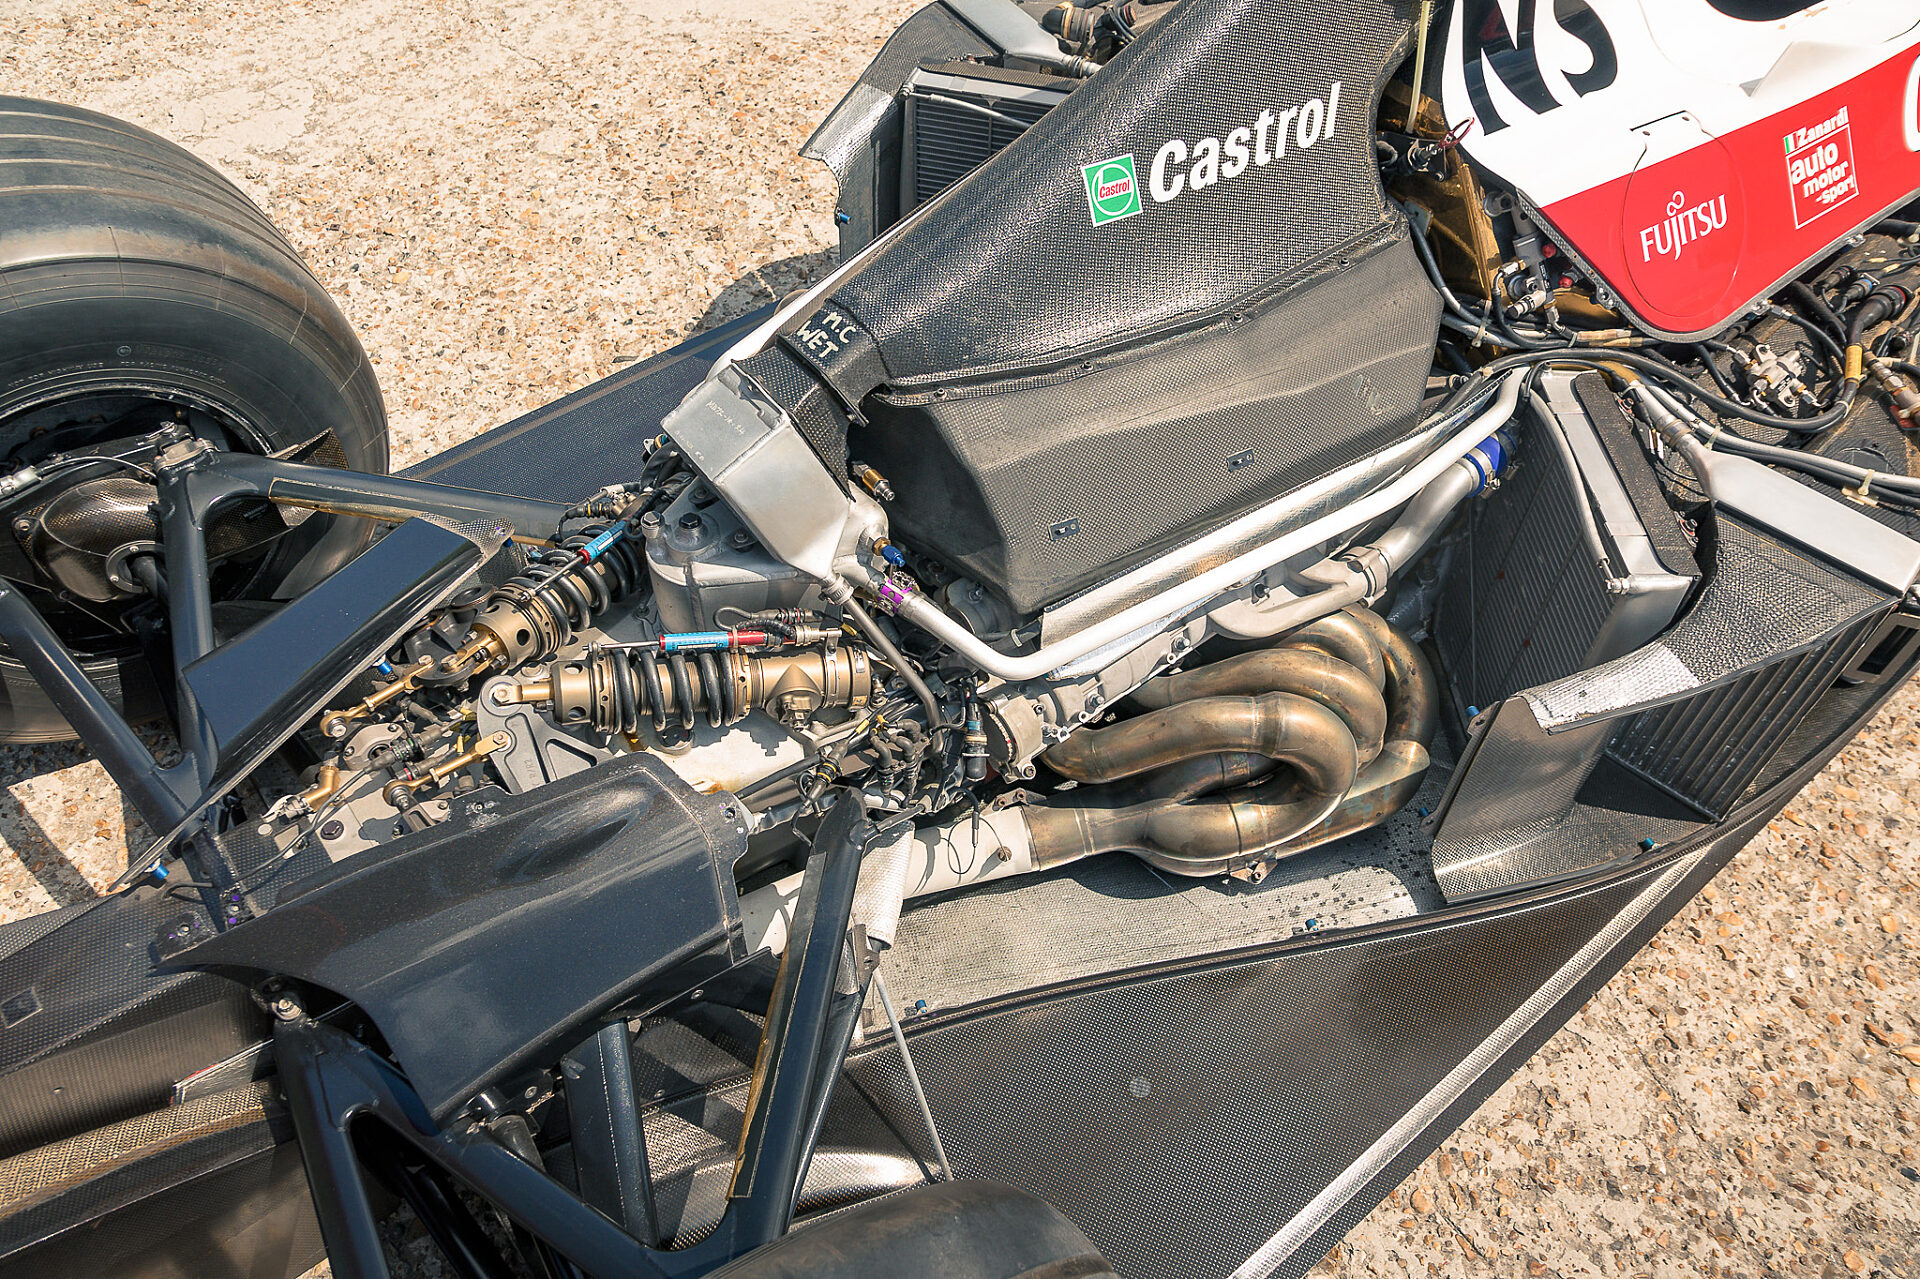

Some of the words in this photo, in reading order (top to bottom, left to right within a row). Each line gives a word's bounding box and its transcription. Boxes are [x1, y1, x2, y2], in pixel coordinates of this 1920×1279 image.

[1149, 81, 1341, 203] Castrol
[1797, 105, 1849, 147] Zanardi
[1790, 142, 1839, 185] auto
[1803, 160, 1849, 198] motor
[1099, 179, 1131, 199] Castrol
[1640, 194, 1728, 263] FUJITSU
[796, 320, 839, 358] WET
